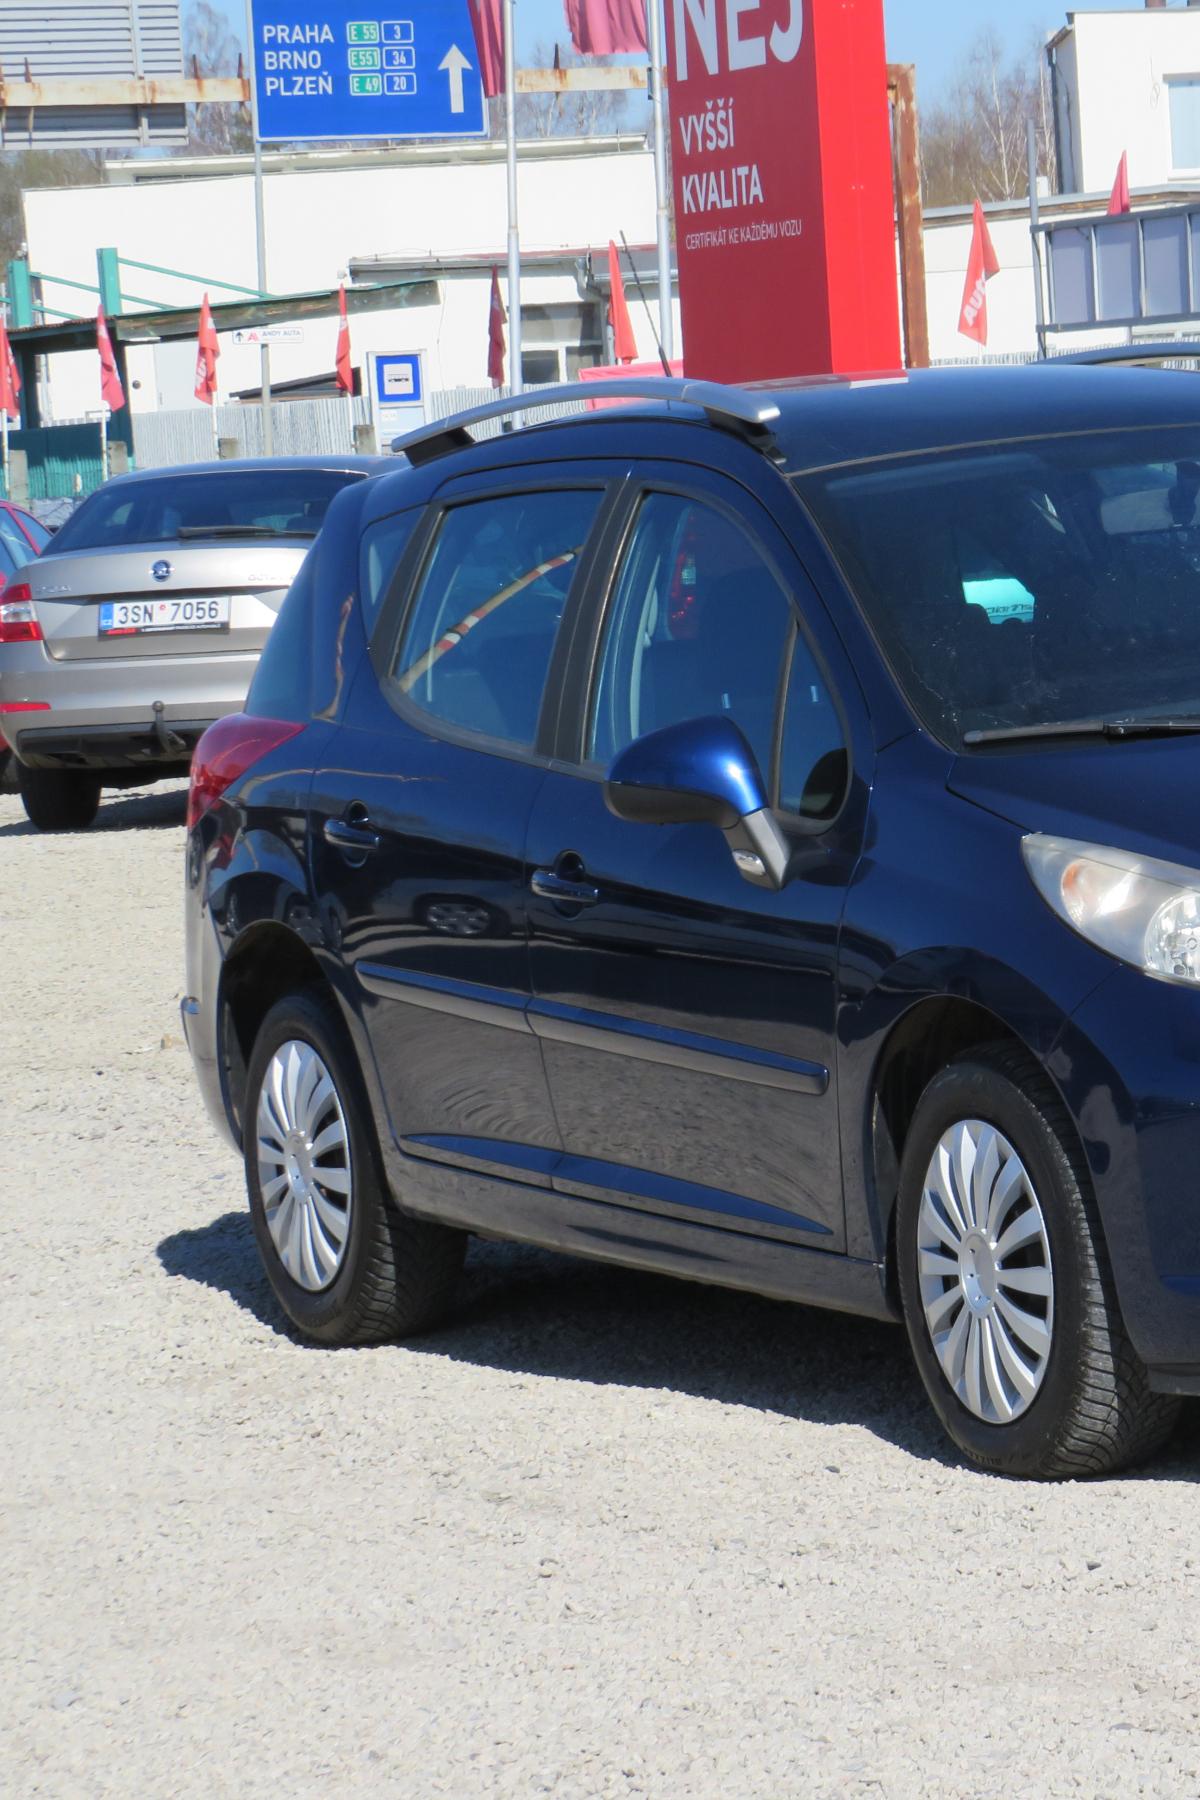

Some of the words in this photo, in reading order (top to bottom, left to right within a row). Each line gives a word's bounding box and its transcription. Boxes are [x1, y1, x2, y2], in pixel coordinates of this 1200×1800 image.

[263, 24, 335, 44] PRAHA
[393, 25, 401, 40] 3
[264, 50, 322, 70] BRNO
[392, 51, 406, 65] 34
[265, 71, 333, 96] PLZEŇ
[393, 76, 407, 91] 20
[679, 97, 735, 155] VYŠŠÍ
[682, 163, 764, 214] KVALITA
[779, 219, 802, 237] VOZU
[962, 268, 987, 327] Aut
[119, 604, 154, 624] 3SN
[171, 600, 220, 621] 7056
